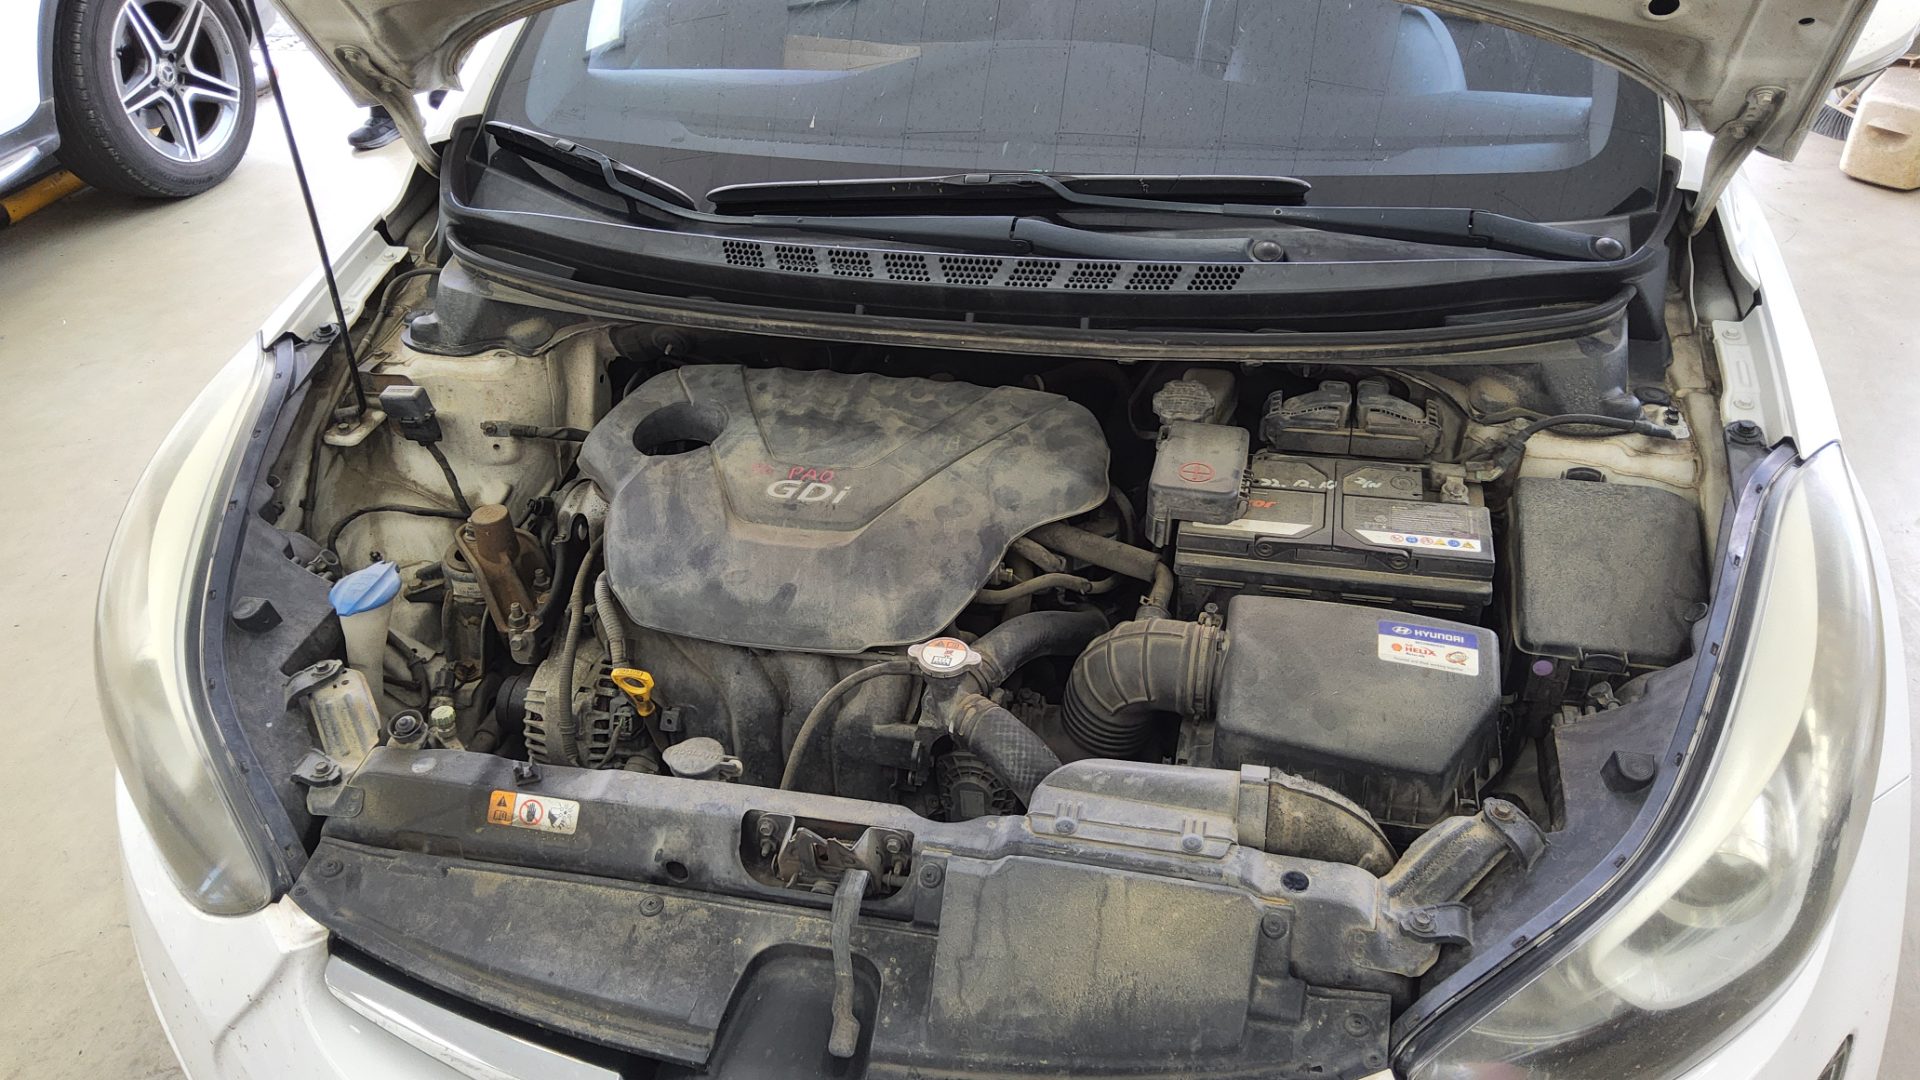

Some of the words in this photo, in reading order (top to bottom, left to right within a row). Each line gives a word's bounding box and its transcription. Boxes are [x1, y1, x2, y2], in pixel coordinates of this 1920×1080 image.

[767, 480, 851, 504] GDi
[1414, 629, 1465, 644] HYUNDAI
[1405, 645, 1437, 657] HELIX
